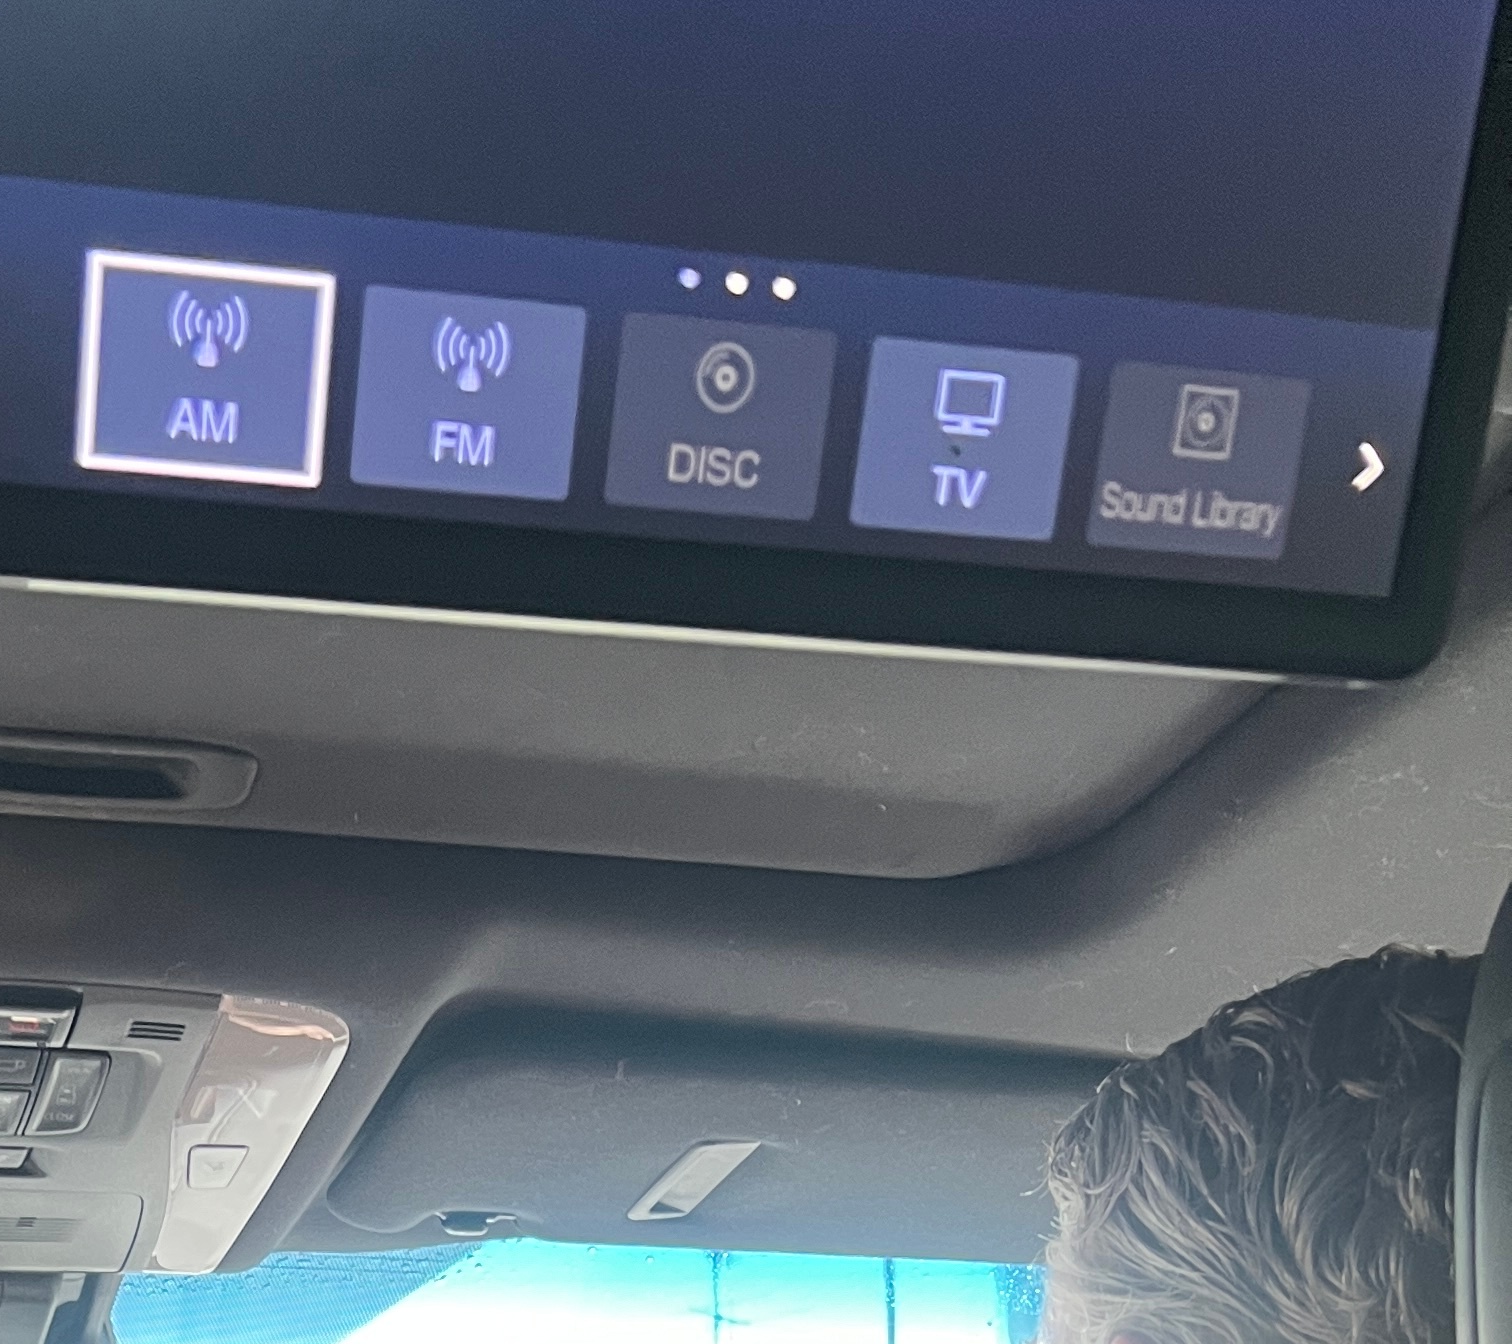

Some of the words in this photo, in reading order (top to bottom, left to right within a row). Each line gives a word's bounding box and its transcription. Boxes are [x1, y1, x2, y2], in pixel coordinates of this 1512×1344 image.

[165, 397, 239, 444] AM
[428, 419, 495, 467] FM
[666, 443, 761, 489] DISC
[932, 465, 988, 509] TV
[1099, 480, 1188, 526] Sound
[1191, 489, 1284, 539] Library
